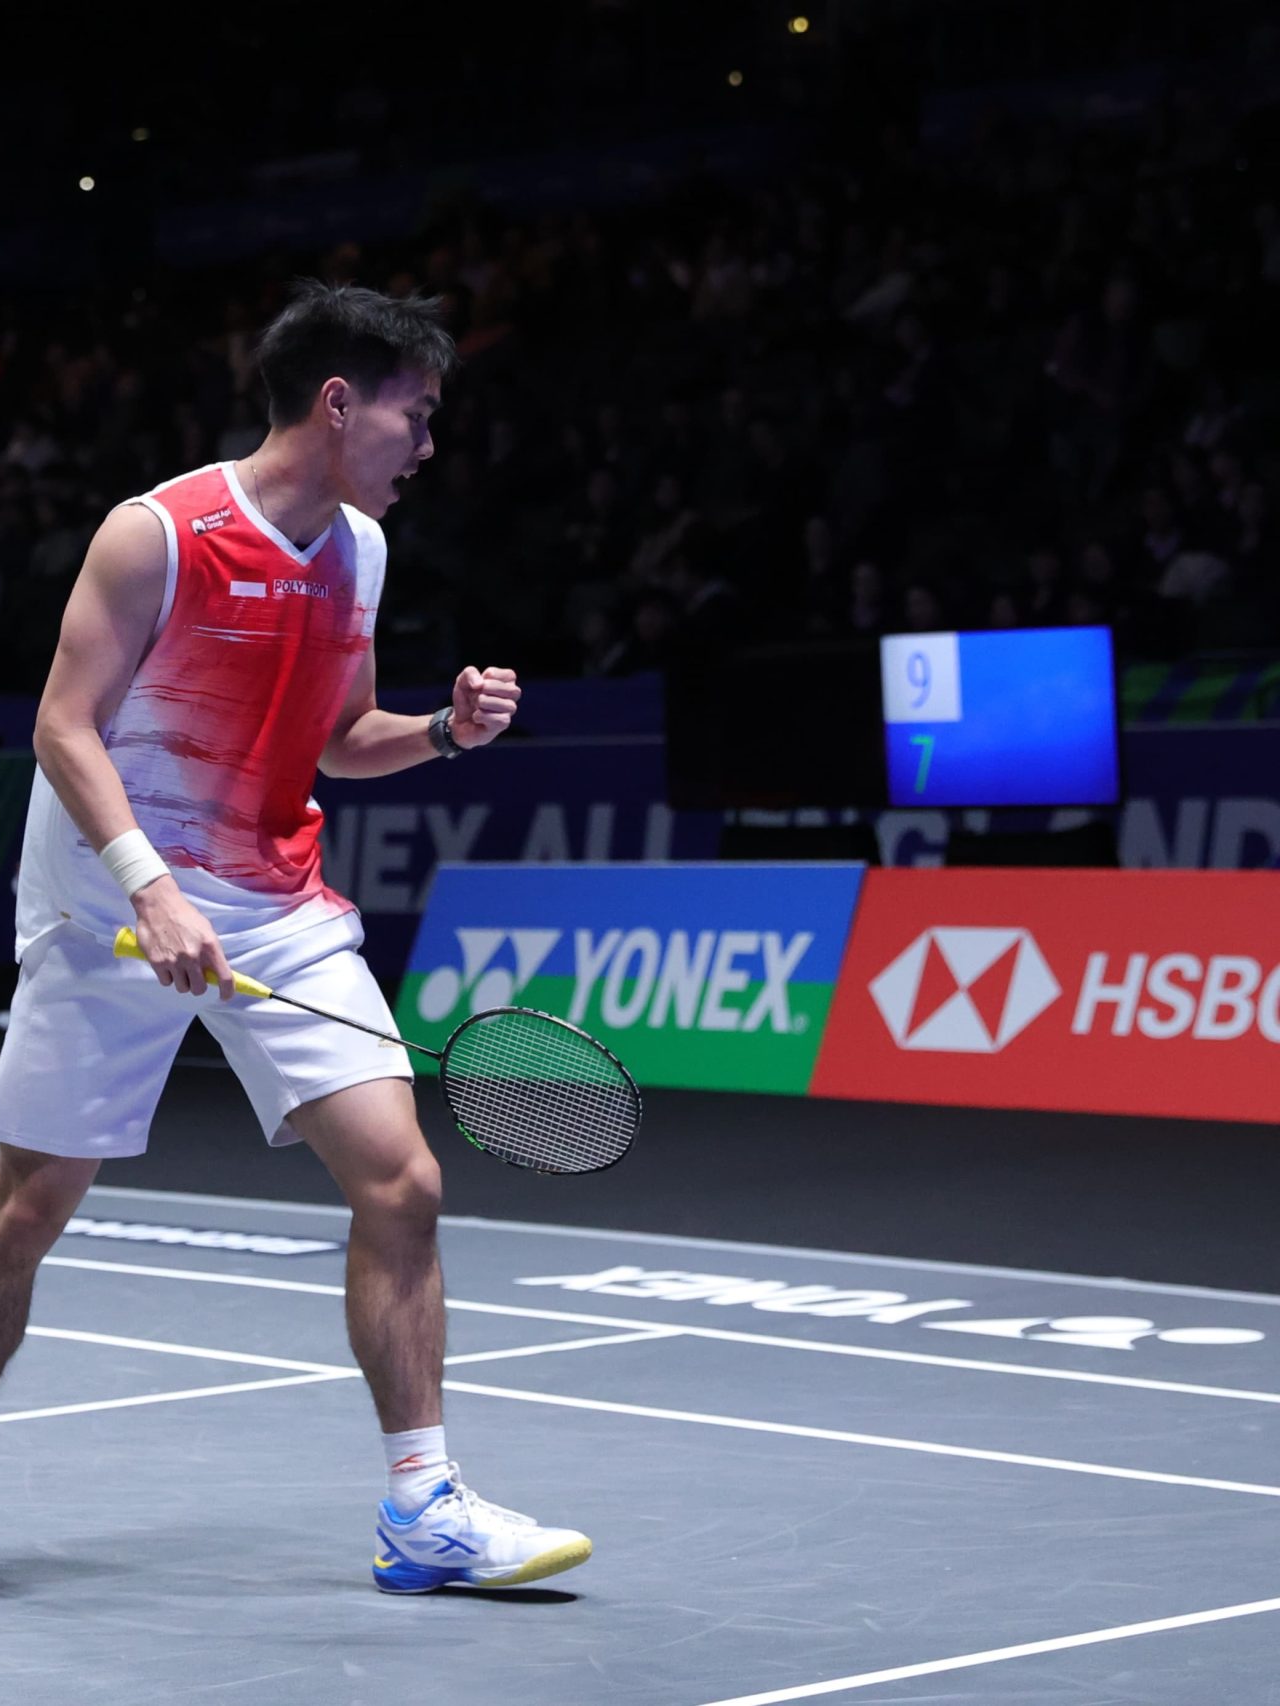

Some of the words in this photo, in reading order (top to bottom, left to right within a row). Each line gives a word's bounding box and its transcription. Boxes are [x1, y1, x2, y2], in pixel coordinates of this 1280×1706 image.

[906, 651, 932, 710] 9
[909, 734, 935, 795] 7
[566, 927, 816, 1034] YONEX
